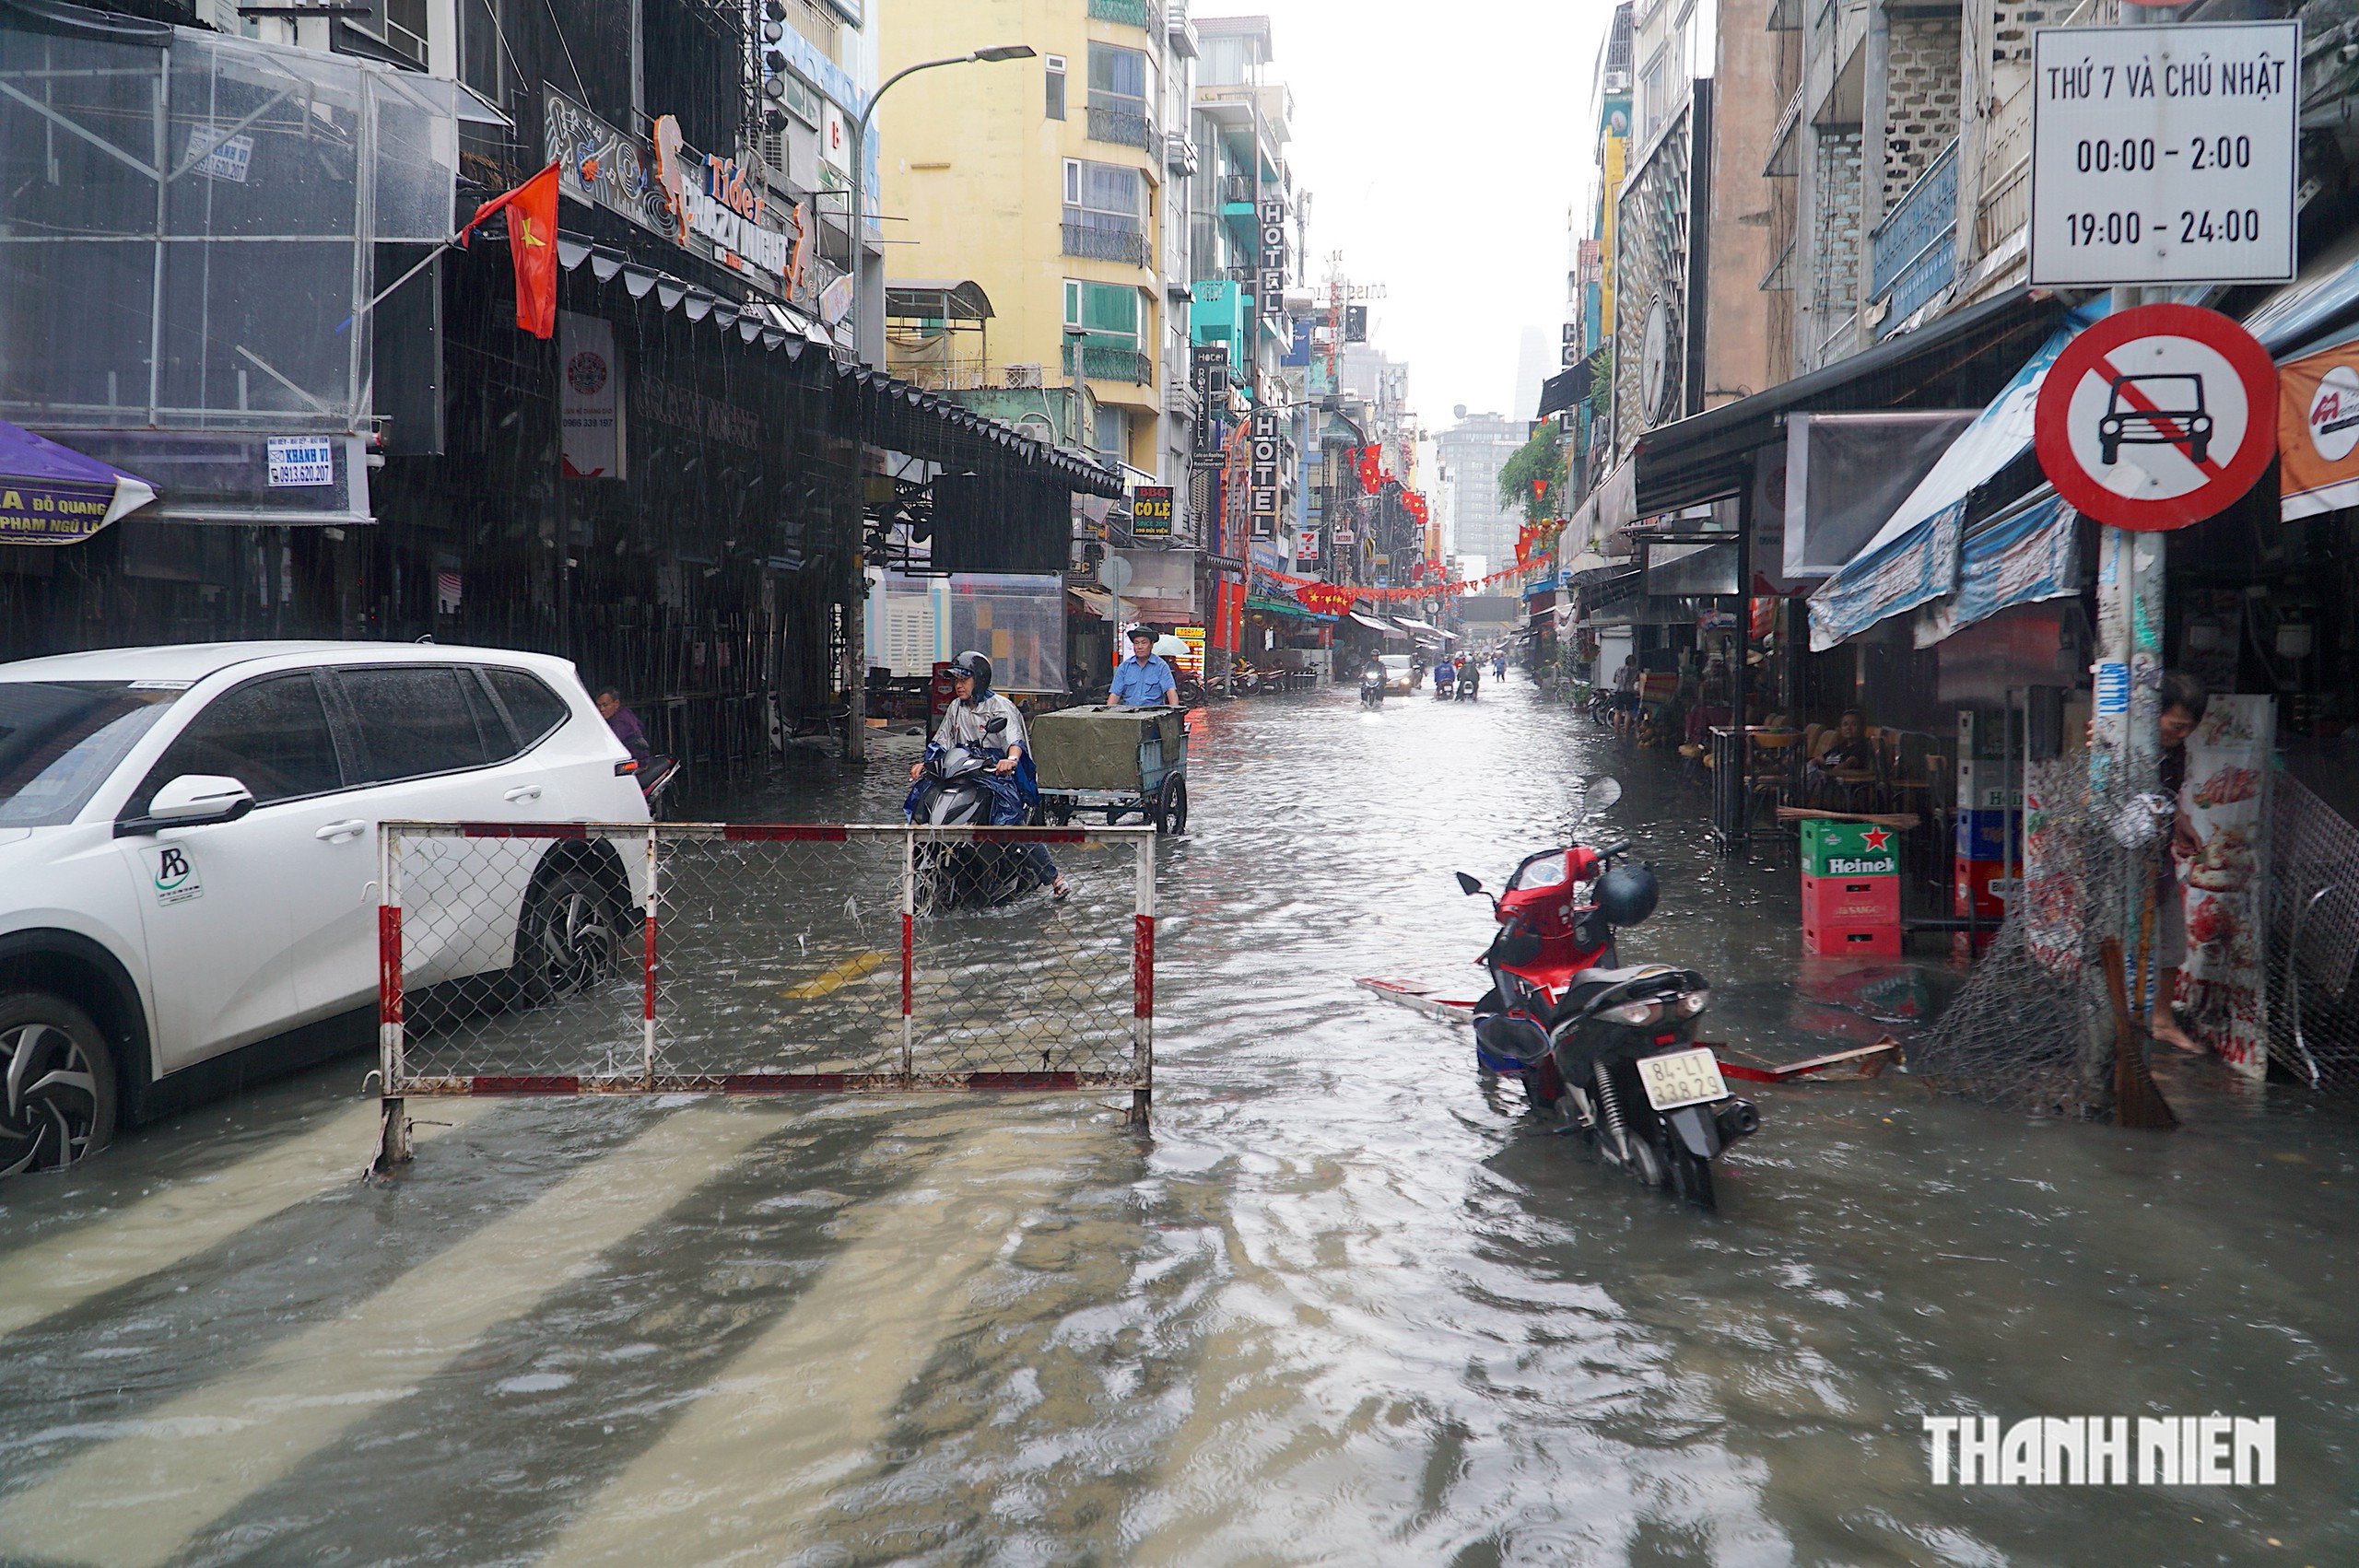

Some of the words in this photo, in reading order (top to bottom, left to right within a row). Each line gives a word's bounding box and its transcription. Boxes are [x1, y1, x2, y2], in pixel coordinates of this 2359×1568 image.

[2047, 56, 2094, 100] THỨ
[2103, 66, 2115, 99] 7
[2126, 55, 2155, 98] VÀ
[2166, 53, 2212, 97] CHỦ
[2222, 52, 2285, 100] NHẬT
[2077, 138, 2154, 173] 00:00
[2191, 135, 2250, 170] 2:00
[2067, 211, 2141, 246] 19:00
[2180, 208, 2259, 243] 24:00
[1264, 205, 1282, 312] HOTEL
[1198, 353, 1224, 362] Hotel
[1197, 368, 1206, 448] ROSABELLA
[286, 445, 317, 462] KHÁNH
[320, 448, 328, 462] VI
[280, 464, 329, 483] 0913.620.207
[1255, 416, 1273, 535] HOTEL
[0, 490, 25, 509] A
[59, 500, 107, 516] QUANG
[1139, 487, 1168, 497] BBQ
[1134, 498, 1152, 516] CÔ
[1155, 499, 1171, 520] LỆ
[0, 517, 46, 533] PHẠM
[50, 519, 80, 533] NGŨ
[1652, 1056, 1704, 1081] 84-L1
